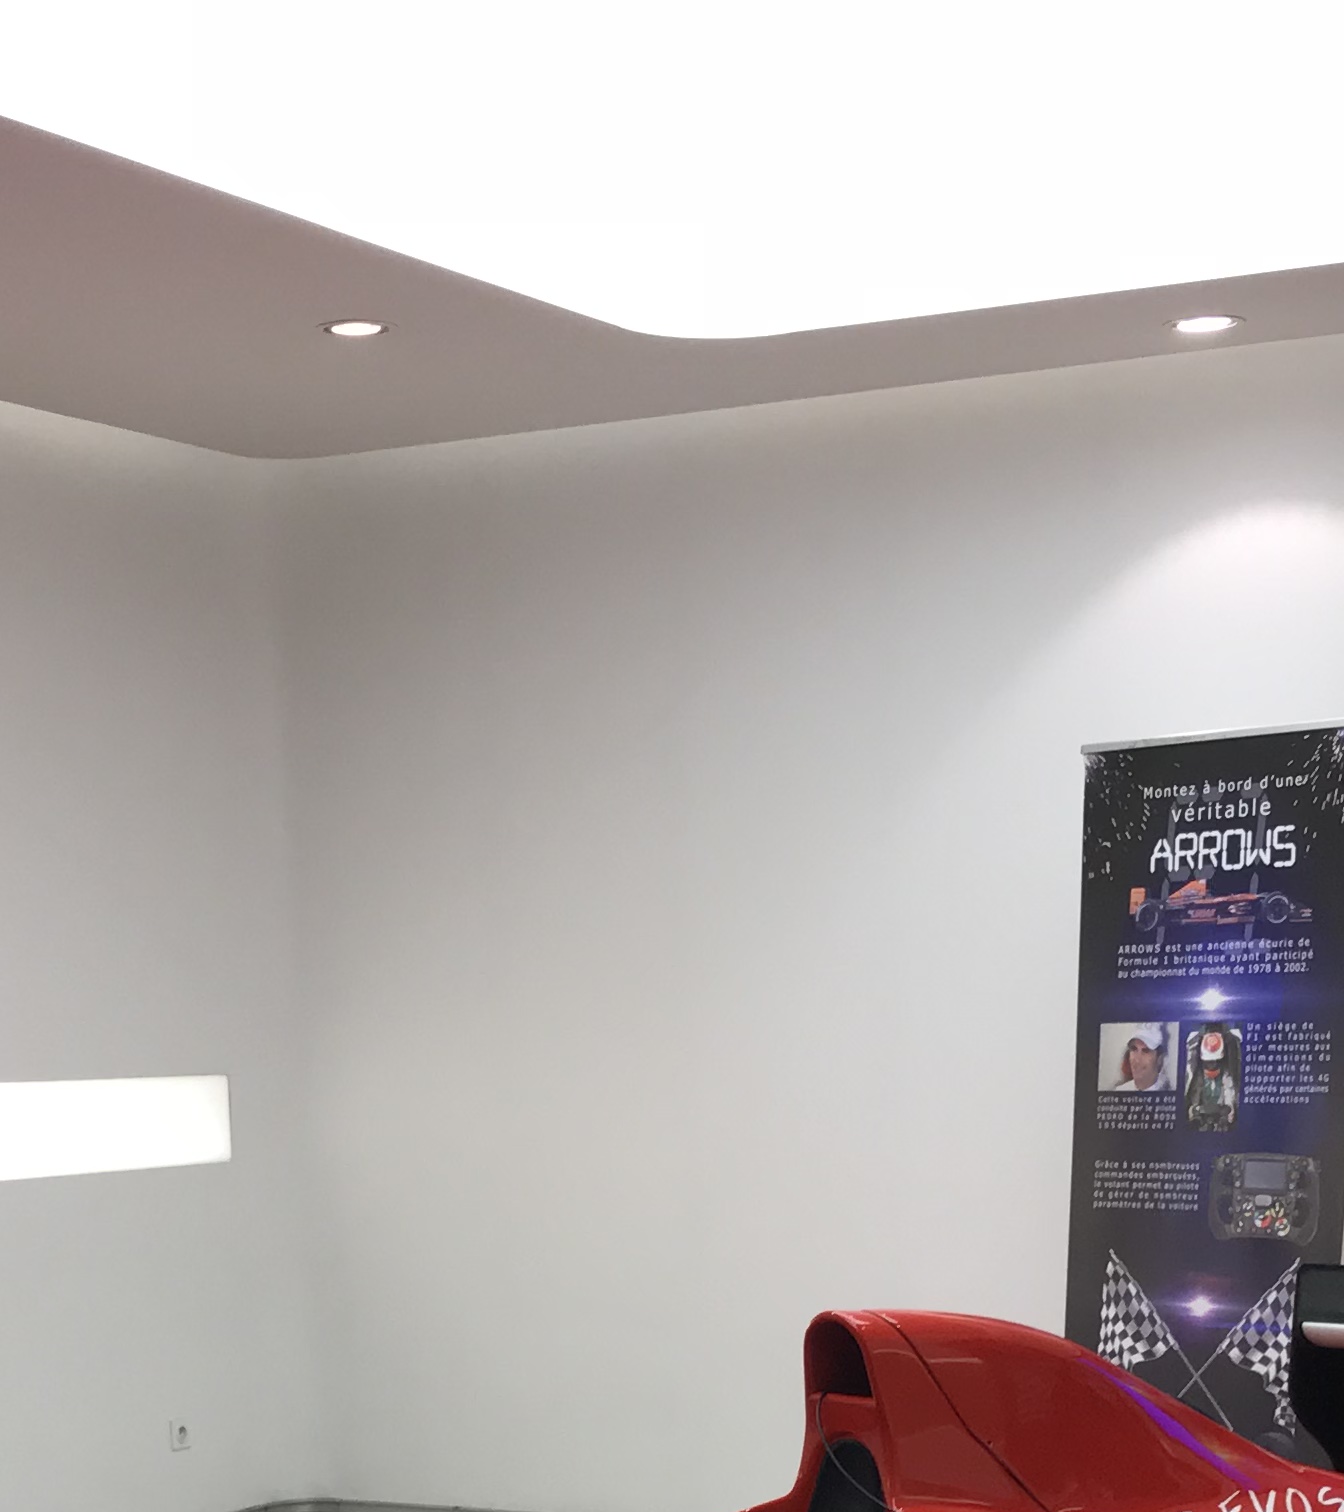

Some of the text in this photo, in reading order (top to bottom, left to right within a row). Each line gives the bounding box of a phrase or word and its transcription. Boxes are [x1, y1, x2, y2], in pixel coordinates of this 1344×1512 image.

[1143, 775, 1303, 799] Montez à bord d'une
[1171, 798, 1272, 822] véritable
[1150, 824, 1297, 873] ARROWS
[1118, 944, 1160, 954] ARROWS
[1165, 944, 1181, 952] est
[1207, 941, 1254, 950] ancienne
[1298, 937, 1310, 947] de
[1118, 956, 1158, 966] Formule
[1164, 956, 1168, 965] 1
[1230, 952, 1259, 963] ayant
[1265, 949, 1313, 962] participé
[1118, 970, 1128, 978] au
[1188, 967, 1199, 976] du
[1233, 964, 1244, 974] de
[1248, 964, 1271, 974] 1978
[1275, 962, 1280, 972] à
[1284, 962, 1309, 972] 2002.
